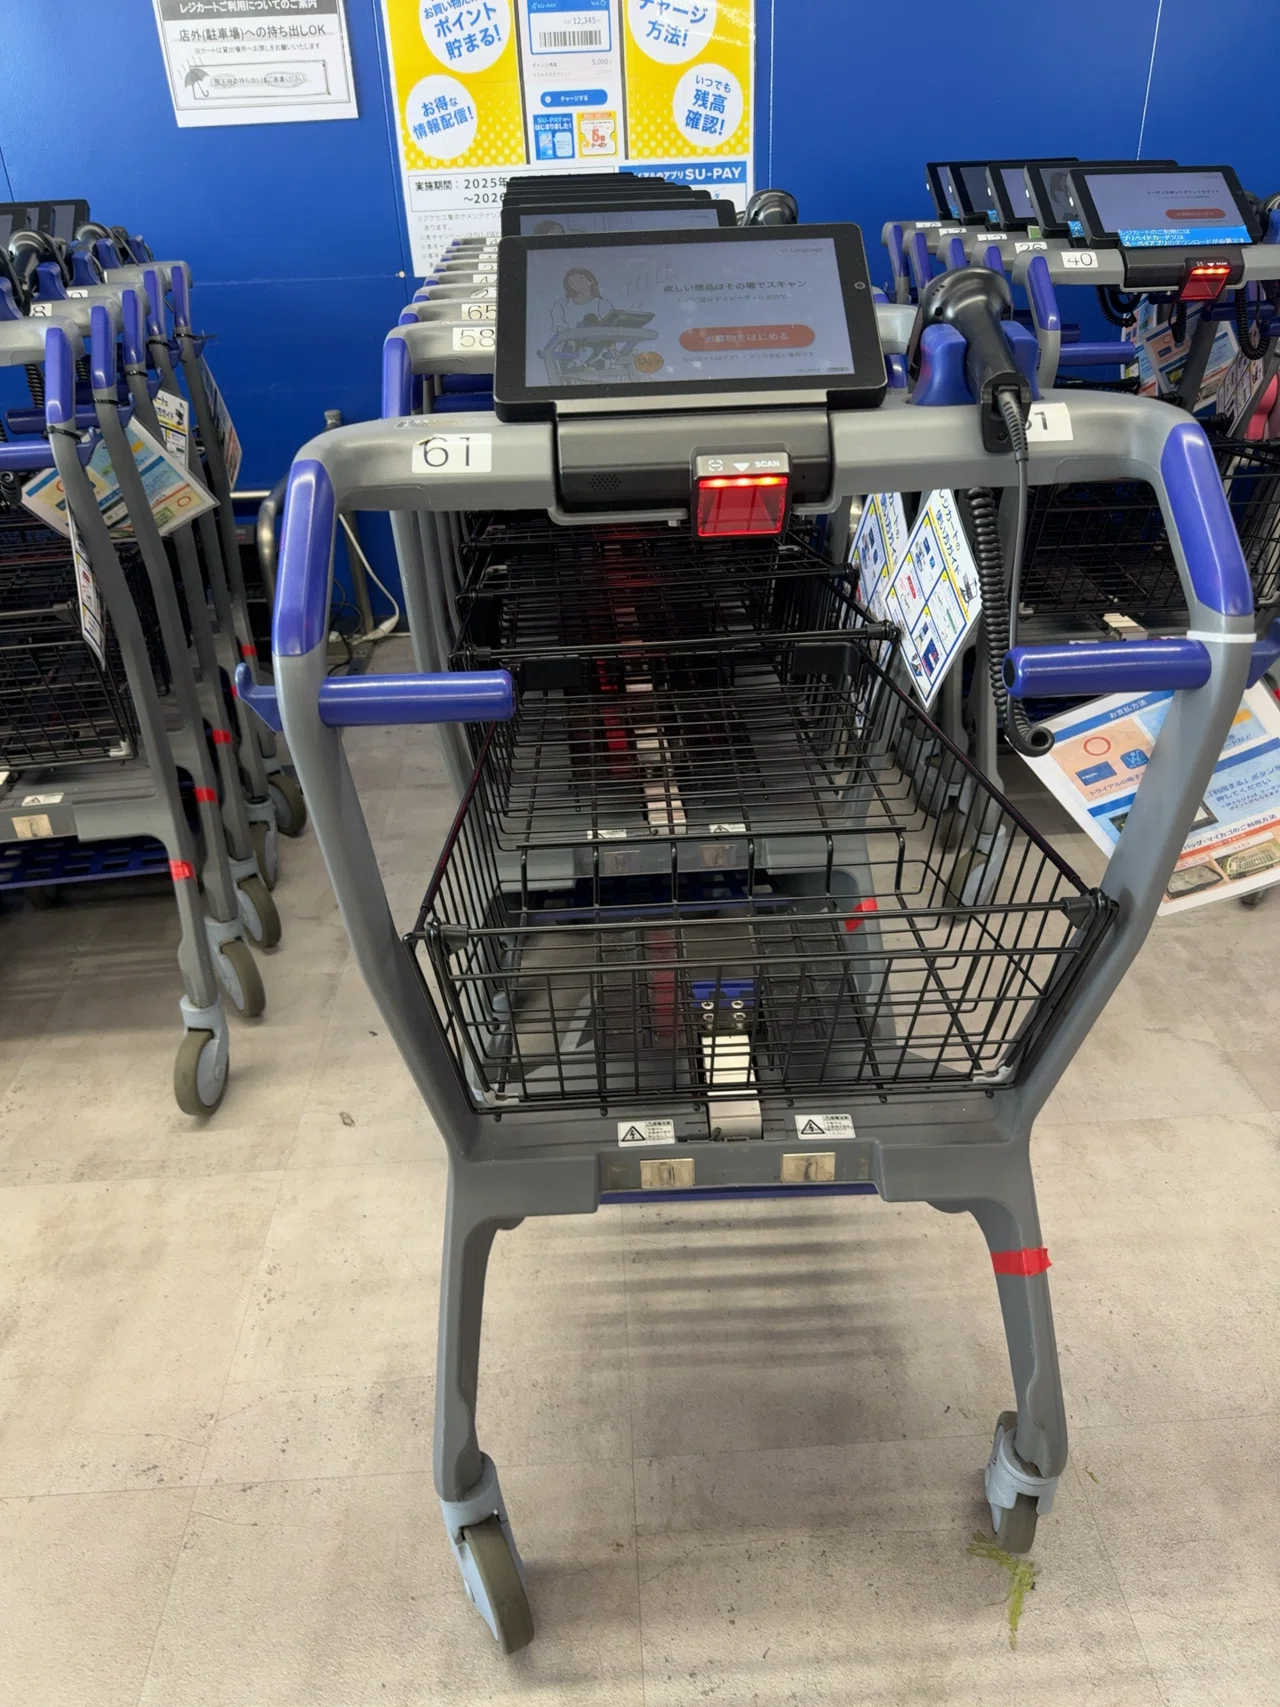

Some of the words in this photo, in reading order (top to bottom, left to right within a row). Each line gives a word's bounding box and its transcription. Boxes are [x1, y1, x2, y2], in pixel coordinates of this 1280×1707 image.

[434, 2, 497, 38] ポイント
[573, 16, 597, 25] 12,345
[179, 23, 326, 42] 店外(駐車場)への持ち出しOK
[445, 24, 502, 60] 貯まる!
[646, 20, 689, 48] 方法!
[696, 75, 731, 94] いつでも
[421, 95, 459, 118] お得な
[692, 88, 727, 115] 残高
[412, 106, 474, 141] 情報配信!
[685, 109, 725, 136] 確認!
[685, 167, 742, 181] SU-PAY
[1066, 252, 1093, 268] 40
[663, 280, 807, 294] 欲しい商品はその場でスキャン
[460, 329, 496, 348] 58
[423, 436, 471, 468] 61
[754, 460, 780, 469] SCAN
